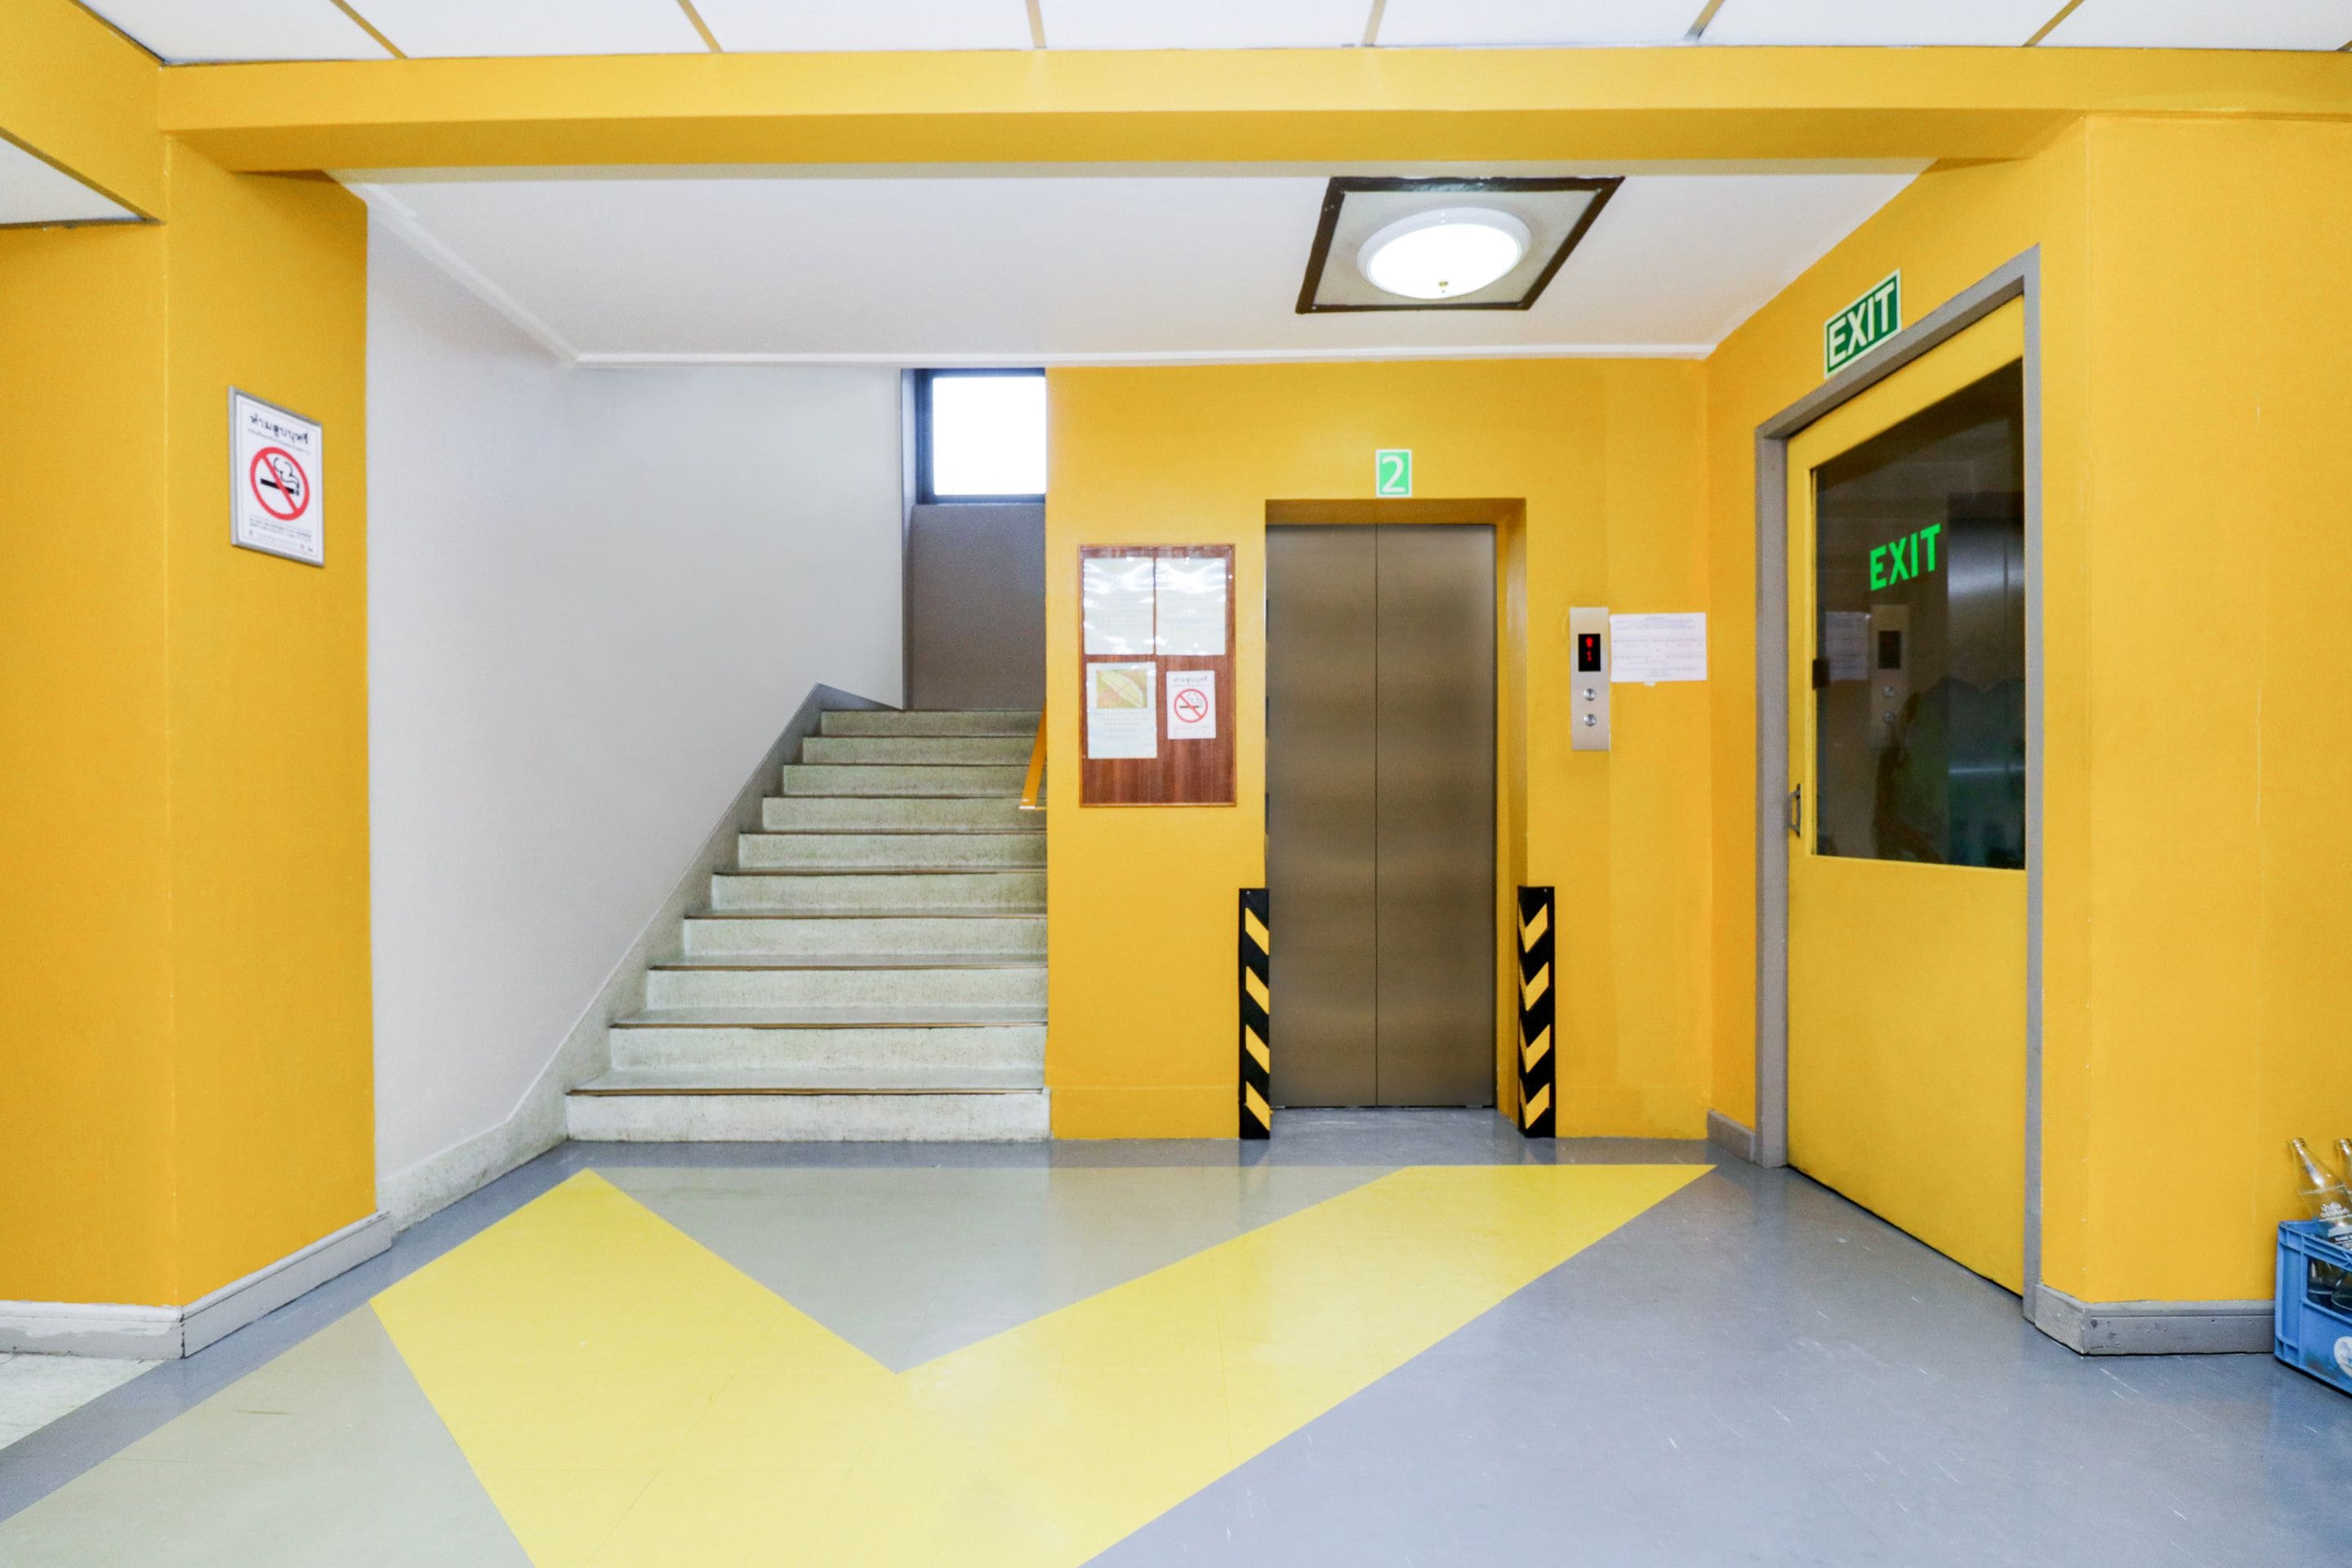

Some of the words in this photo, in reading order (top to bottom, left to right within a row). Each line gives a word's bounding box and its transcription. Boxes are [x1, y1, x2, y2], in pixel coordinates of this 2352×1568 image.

[1829, 282, 1895, 368] EXIT
[1381, 455, 1405, 493] 2
[1869, 523, 1942, 591] EXIT
[1584, 649, 1592, 662] 1
